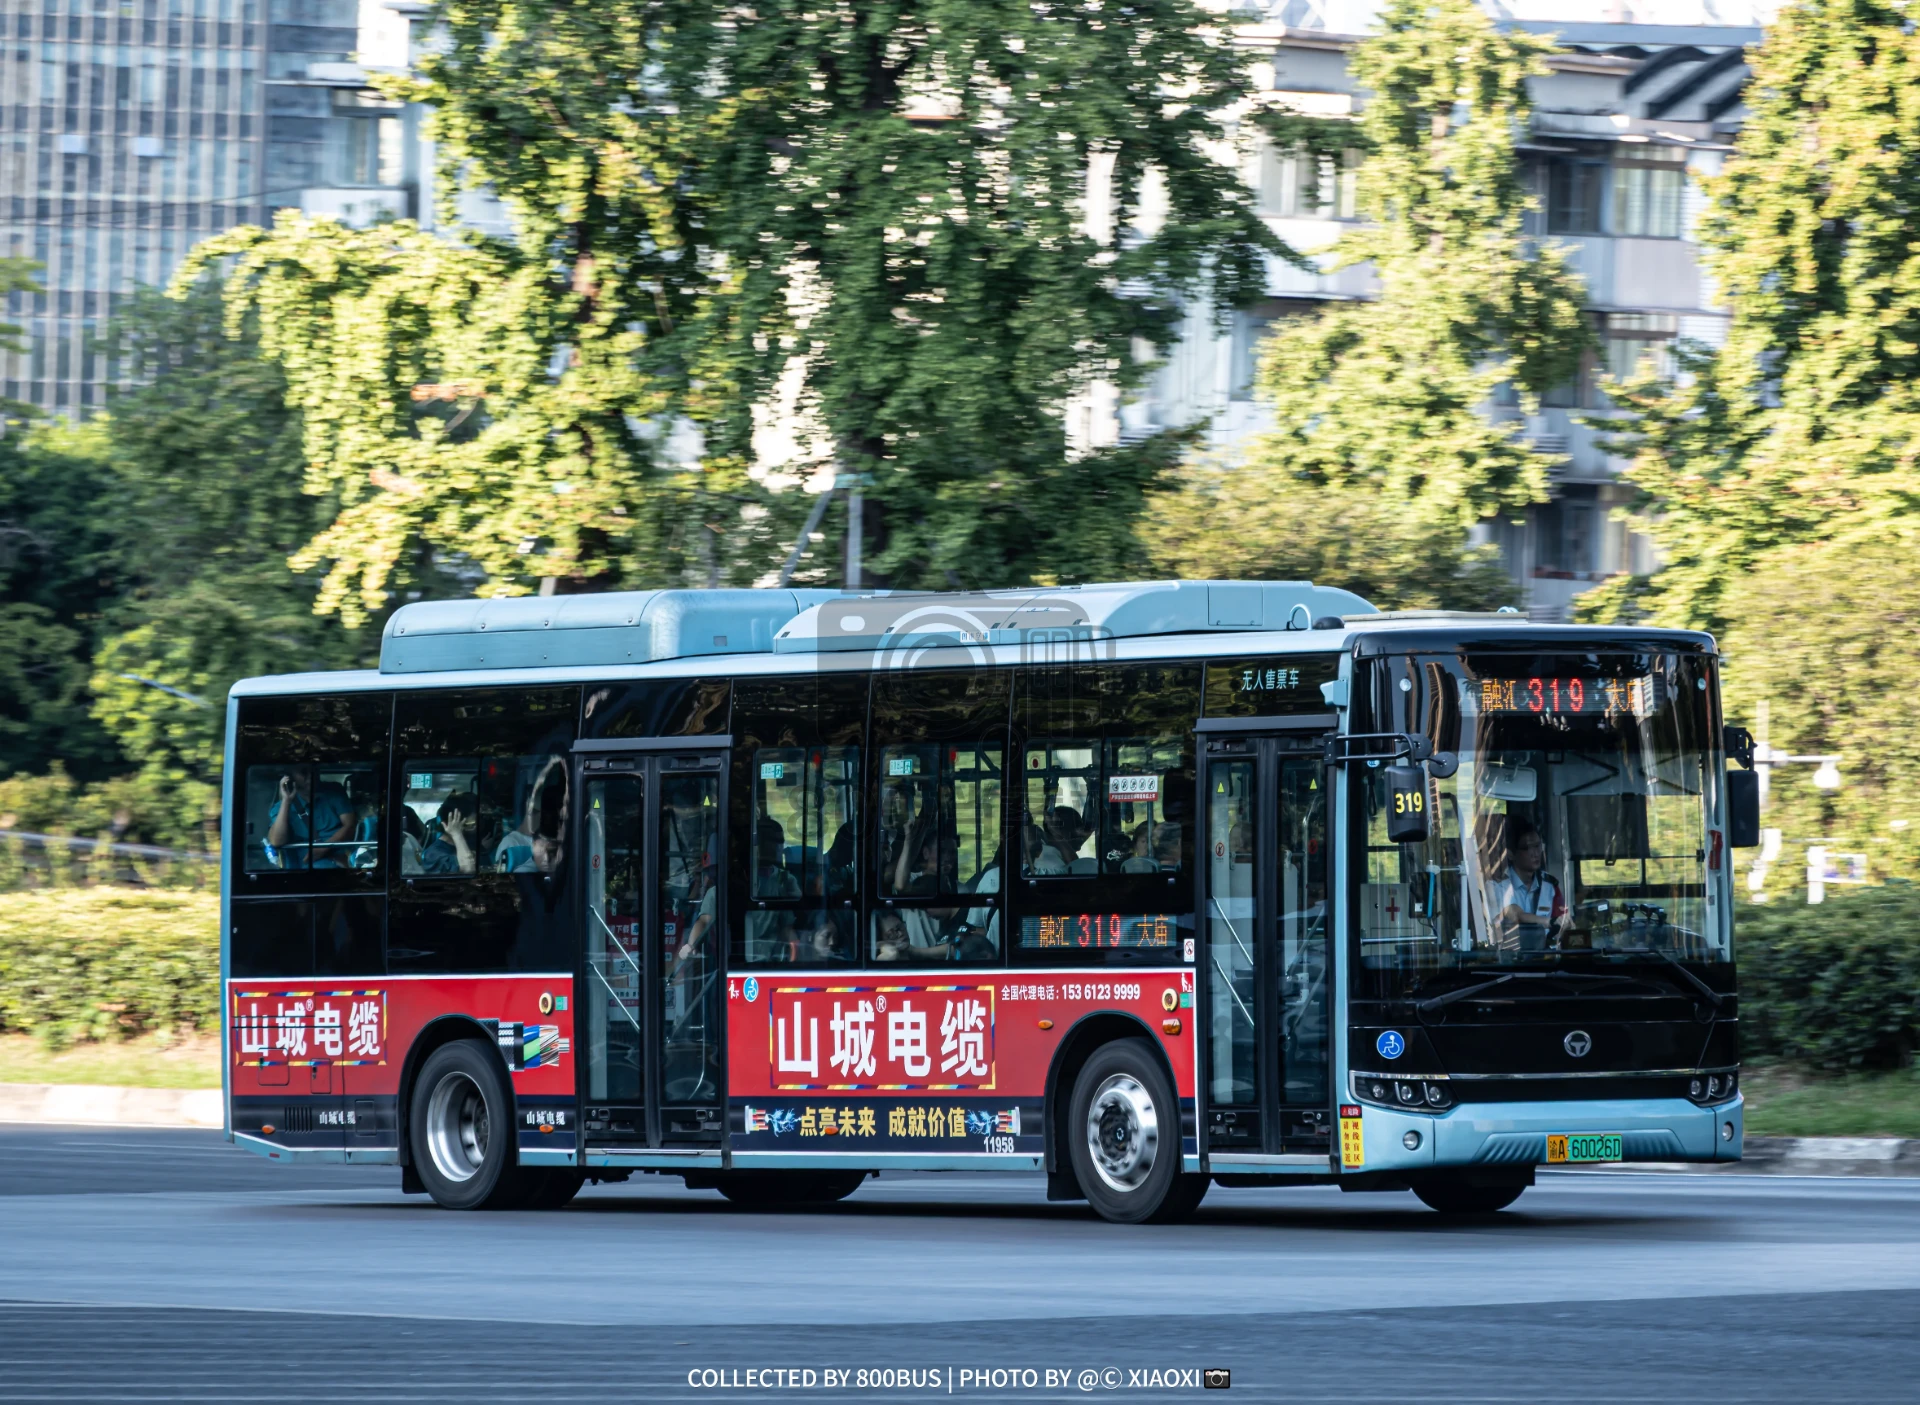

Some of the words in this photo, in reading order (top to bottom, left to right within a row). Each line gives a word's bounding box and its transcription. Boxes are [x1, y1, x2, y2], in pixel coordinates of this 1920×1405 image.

[1241, 667, 1299, 691] 无人售票车
[1481, 678, 1518, 712] 融汇
[1528, 678, 1584, 712] 319
[1395, 792, 1423, 814] 319
[1040, 914, 1070, 948] 融汇
[1078, 914, 1121, 948] 319
[1137, 914, 1169, 947] 大庙
[1061, 984, 1082, 1000] 153
[1084, 984, 1111, 1000] 6123
[1113, 983, 1141, 1000] 9999
[800, 1106, 876, 1138] 点亮未来
[888, 1106, 967, 1138] 成就价值
[983, 1136, 1015, 1154] 11958
